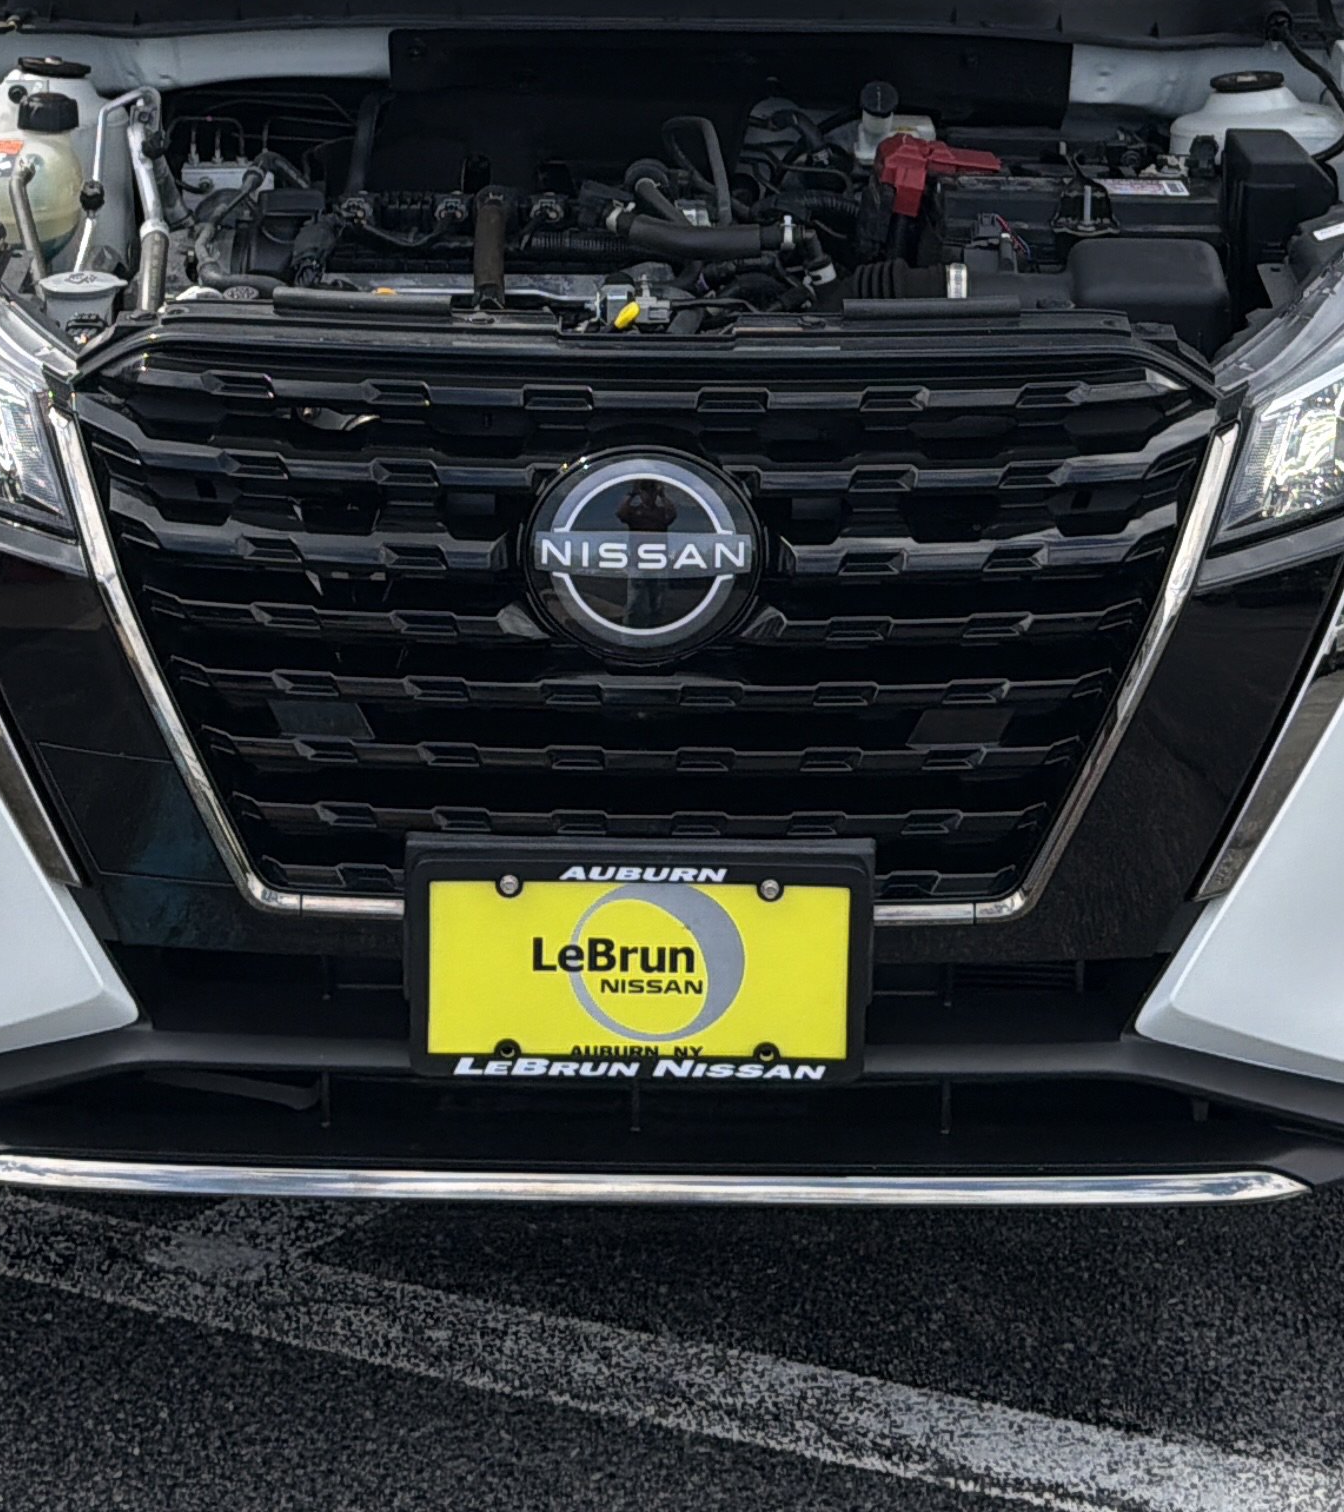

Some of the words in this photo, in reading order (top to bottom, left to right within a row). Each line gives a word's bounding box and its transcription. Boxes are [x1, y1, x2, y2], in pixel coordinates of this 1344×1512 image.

[540, 538, 745, 570] NISSAN
[559, 866, 727, 883] AUBURN
[532, 936, 695, 973] LeBrun
[600, 978, 704, 995] NISSAN
[570, 1045, 660, 1057] AUBURN
[673, 1045, 704, 1058] NY
